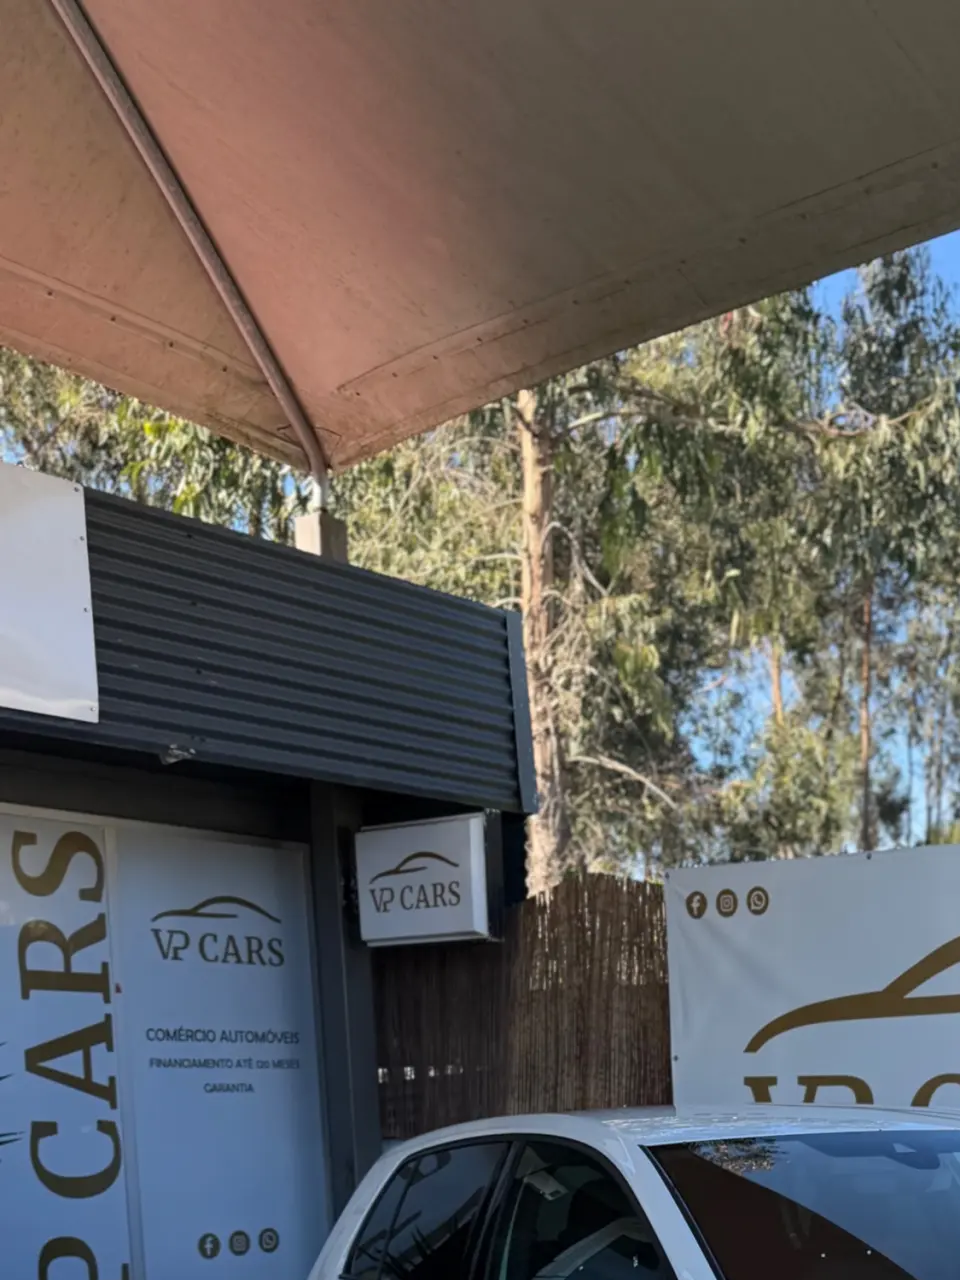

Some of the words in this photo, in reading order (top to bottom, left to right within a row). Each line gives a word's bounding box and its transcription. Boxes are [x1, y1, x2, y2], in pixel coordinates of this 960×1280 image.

[369, 887, 395, 913] VP
[401, 880, 461, 911] CARS
[151, 928, 190, 961] VP
[198, 933, 285, 967] CARS
[11, 830, 122, 1199] CARS
[146, 1026, 217, 1043] COMÉRCIO
[220, 1029, 300, 1044] AUTOMÓVEIS
[149, 1056, 233, 1069] FINANCIAMENTO
[203, 1082, 255, 1094] GARANTIA
